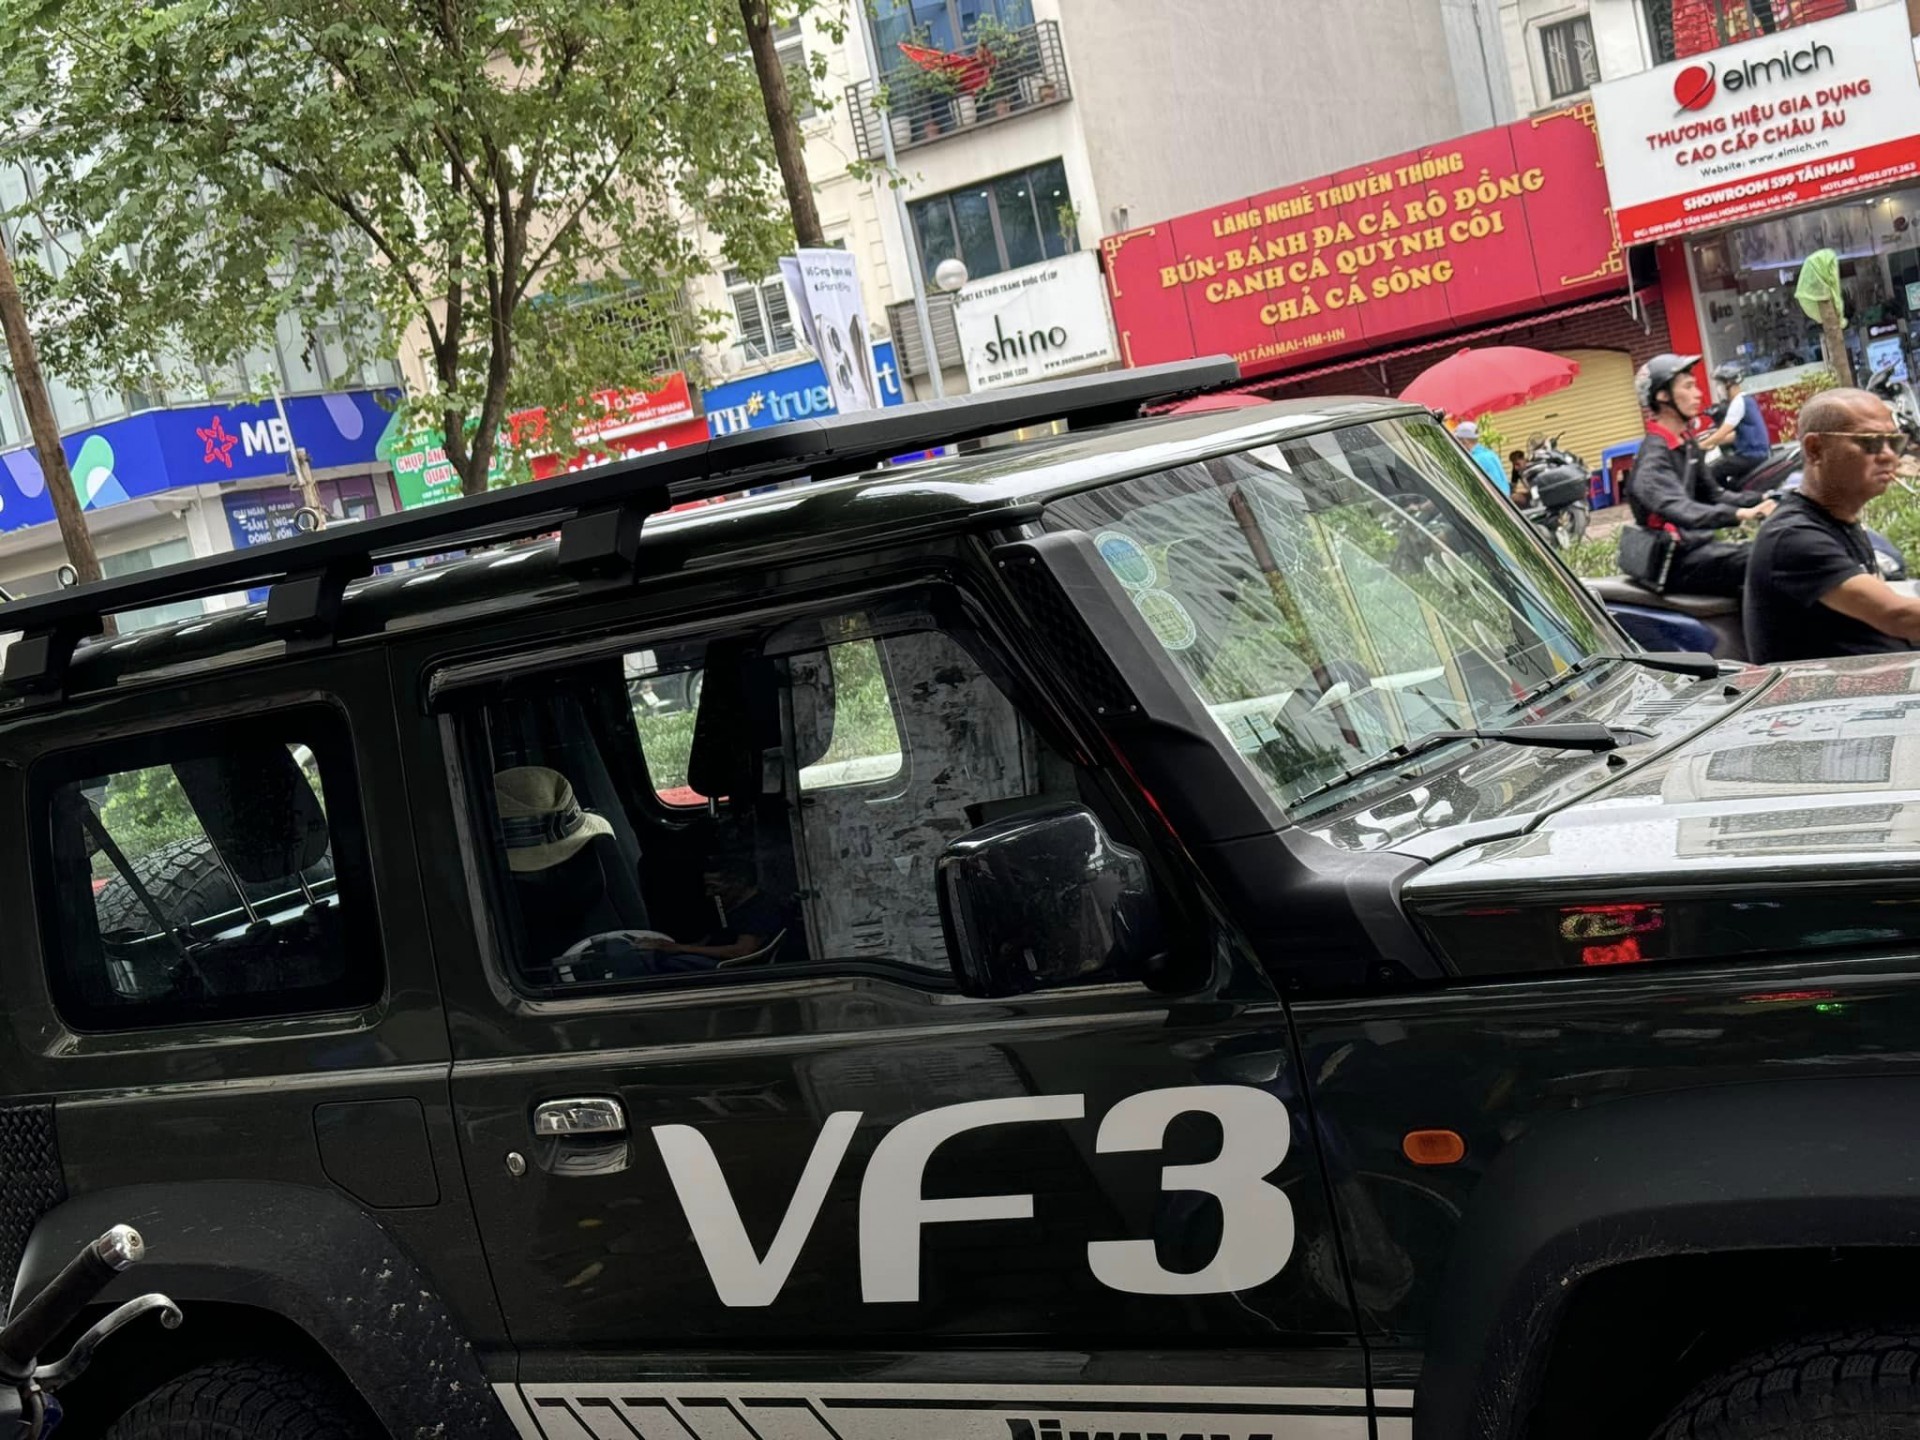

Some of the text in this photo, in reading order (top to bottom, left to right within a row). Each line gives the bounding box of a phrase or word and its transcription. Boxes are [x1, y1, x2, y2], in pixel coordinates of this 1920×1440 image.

[1723, 41, 1834, 92] elmich
[1646, 79, 1872, 151] THƯƠNG HIỆU GIA DỤNG
[1675, 109, 1847, 167] CAO CẤP CHÂU ÂU
[1212, 151, 1464, 238] LÀNG NGHỀ TRUYỀN THỐNG
[1312, 220, 1355, 249] ĐA
[1357, 200, 1401, 235] CÁ
[1403, 188, 1448, 224] RÔ
[1452, 167, 1545, 212] ĐỒNG
[1684, 156, 1857, 211] SHOWROOM 599 TÂN MAI
[1205, 208, 1505, 303] CANH CÁ QUỲNH CÔI
[1259, 259, 1454, 326] CHẢ CÁ SÔNG
[985, 314, 1068, 364] shino
[239, 417, 290, 457] MB
[707, 404, 752, 436] TH
